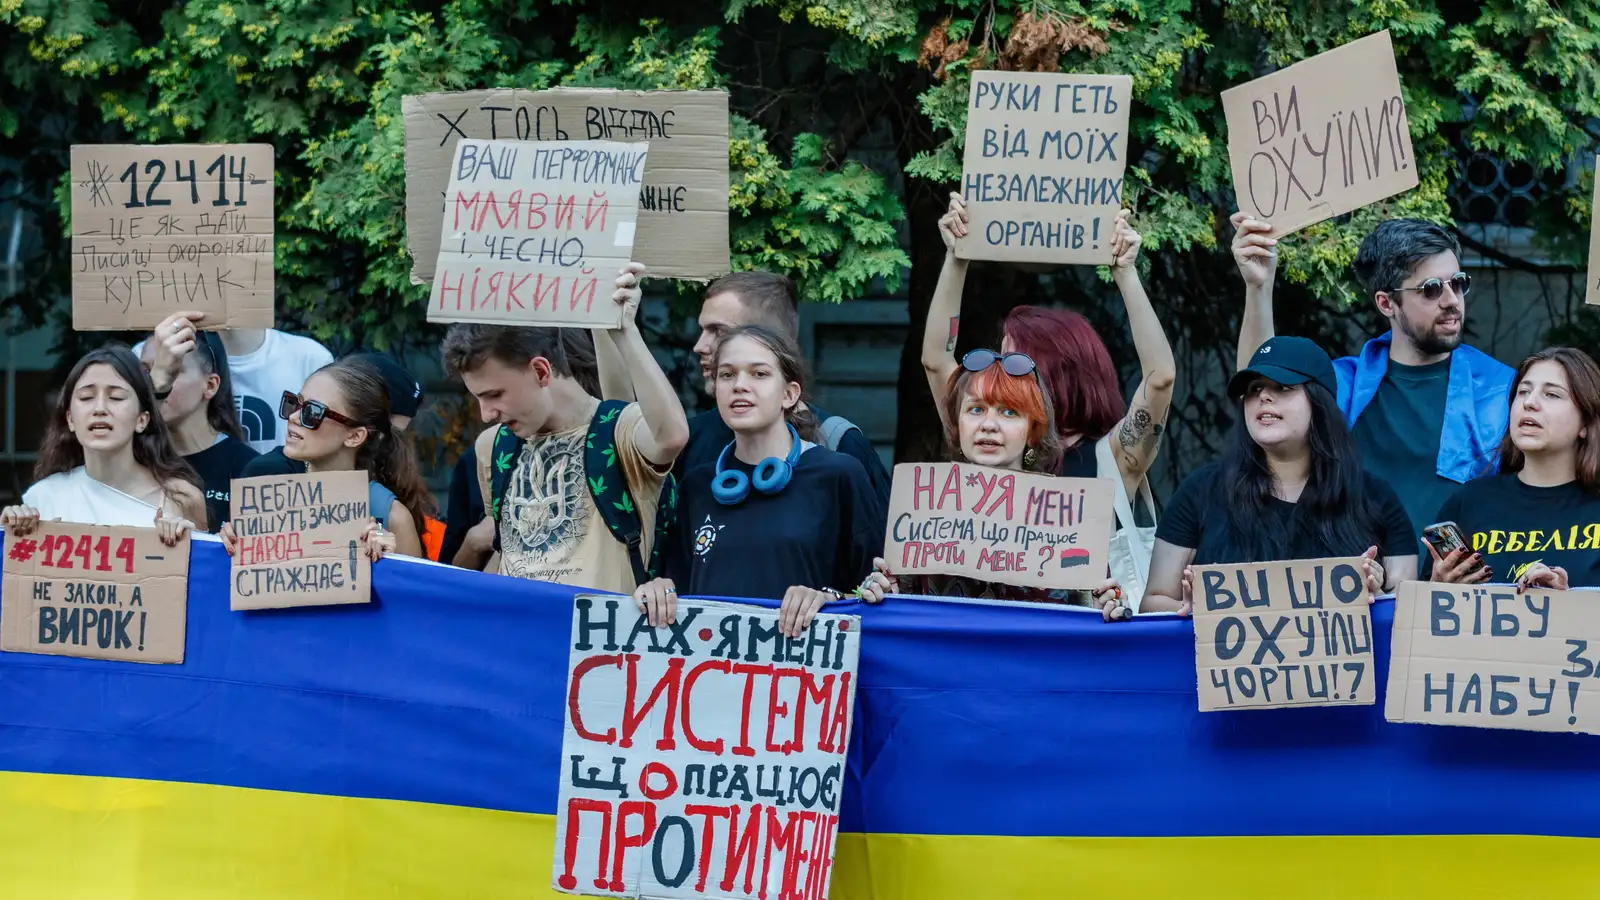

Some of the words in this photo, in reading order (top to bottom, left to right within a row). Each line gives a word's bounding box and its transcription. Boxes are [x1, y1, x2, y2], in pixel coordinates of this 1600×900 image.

[974, 81, 1041, 112] РУКИ
[1055, 84, 1119, 114] ГЕТЬ
[1252, 85, 1301, 145] ВИ
[437, 106, 569, 146] ХТОСЬ
[586, 106, 675, 140] ВІДДАЄ
[982, 124, 1030, 158] ВІД
[1039, 127, 1119, 164] МОЇХ
[457, 143, 518, 183] ВАШ
[533, 147, 648, 186] ПЕРФОРМАНС
[1249, 96, 1408, 218] ОХУЇЛИ?
[964, 173, 1123, 206] НЕЗАЛЕЖНИХ
[109, 217, 144, 245] ЦЕ
[154, 214, 184, 236] ЯК
[195, 209, 247, 236] ДАТИ
[453, 189, 608, 233] МЛЯВИЙ
[484, 234, 586, 268] ЧЕСНО,
[439, 266, 599, 313] НІЯКИЙ
[240, 480, 323, 515] ДЕБІЛИ
[1025, 486, 1085, 527] МЕНІ
[234, 509, 307, 536] ПИШУТЬ
[309, 501, 367, 529] ЗАКОНИ
[8, 534, 135, 574] #12414
[240, 532, 303, 565] НАРОД
[902, 541, 965, 568] ПРОТИ
[33, 582, 51, 600] НЕ
[64, 583, 123, 609] ЗАКОН,
[130, 586, 143, 607] А
[1201, 568, 1271, 611] ВИ
[1285, 563, 1363, 609] ШО
[38, 607, 147, 652] ВИРОК!
[1214, 611, 1371, 665] ОХУЇЛИ
[1210, 662, 1365, 704] ЧОРТИ!?
[1424, 672, 1580, 726] НАБУ!
[568, 654, 851, 756] СИСТЕМА
